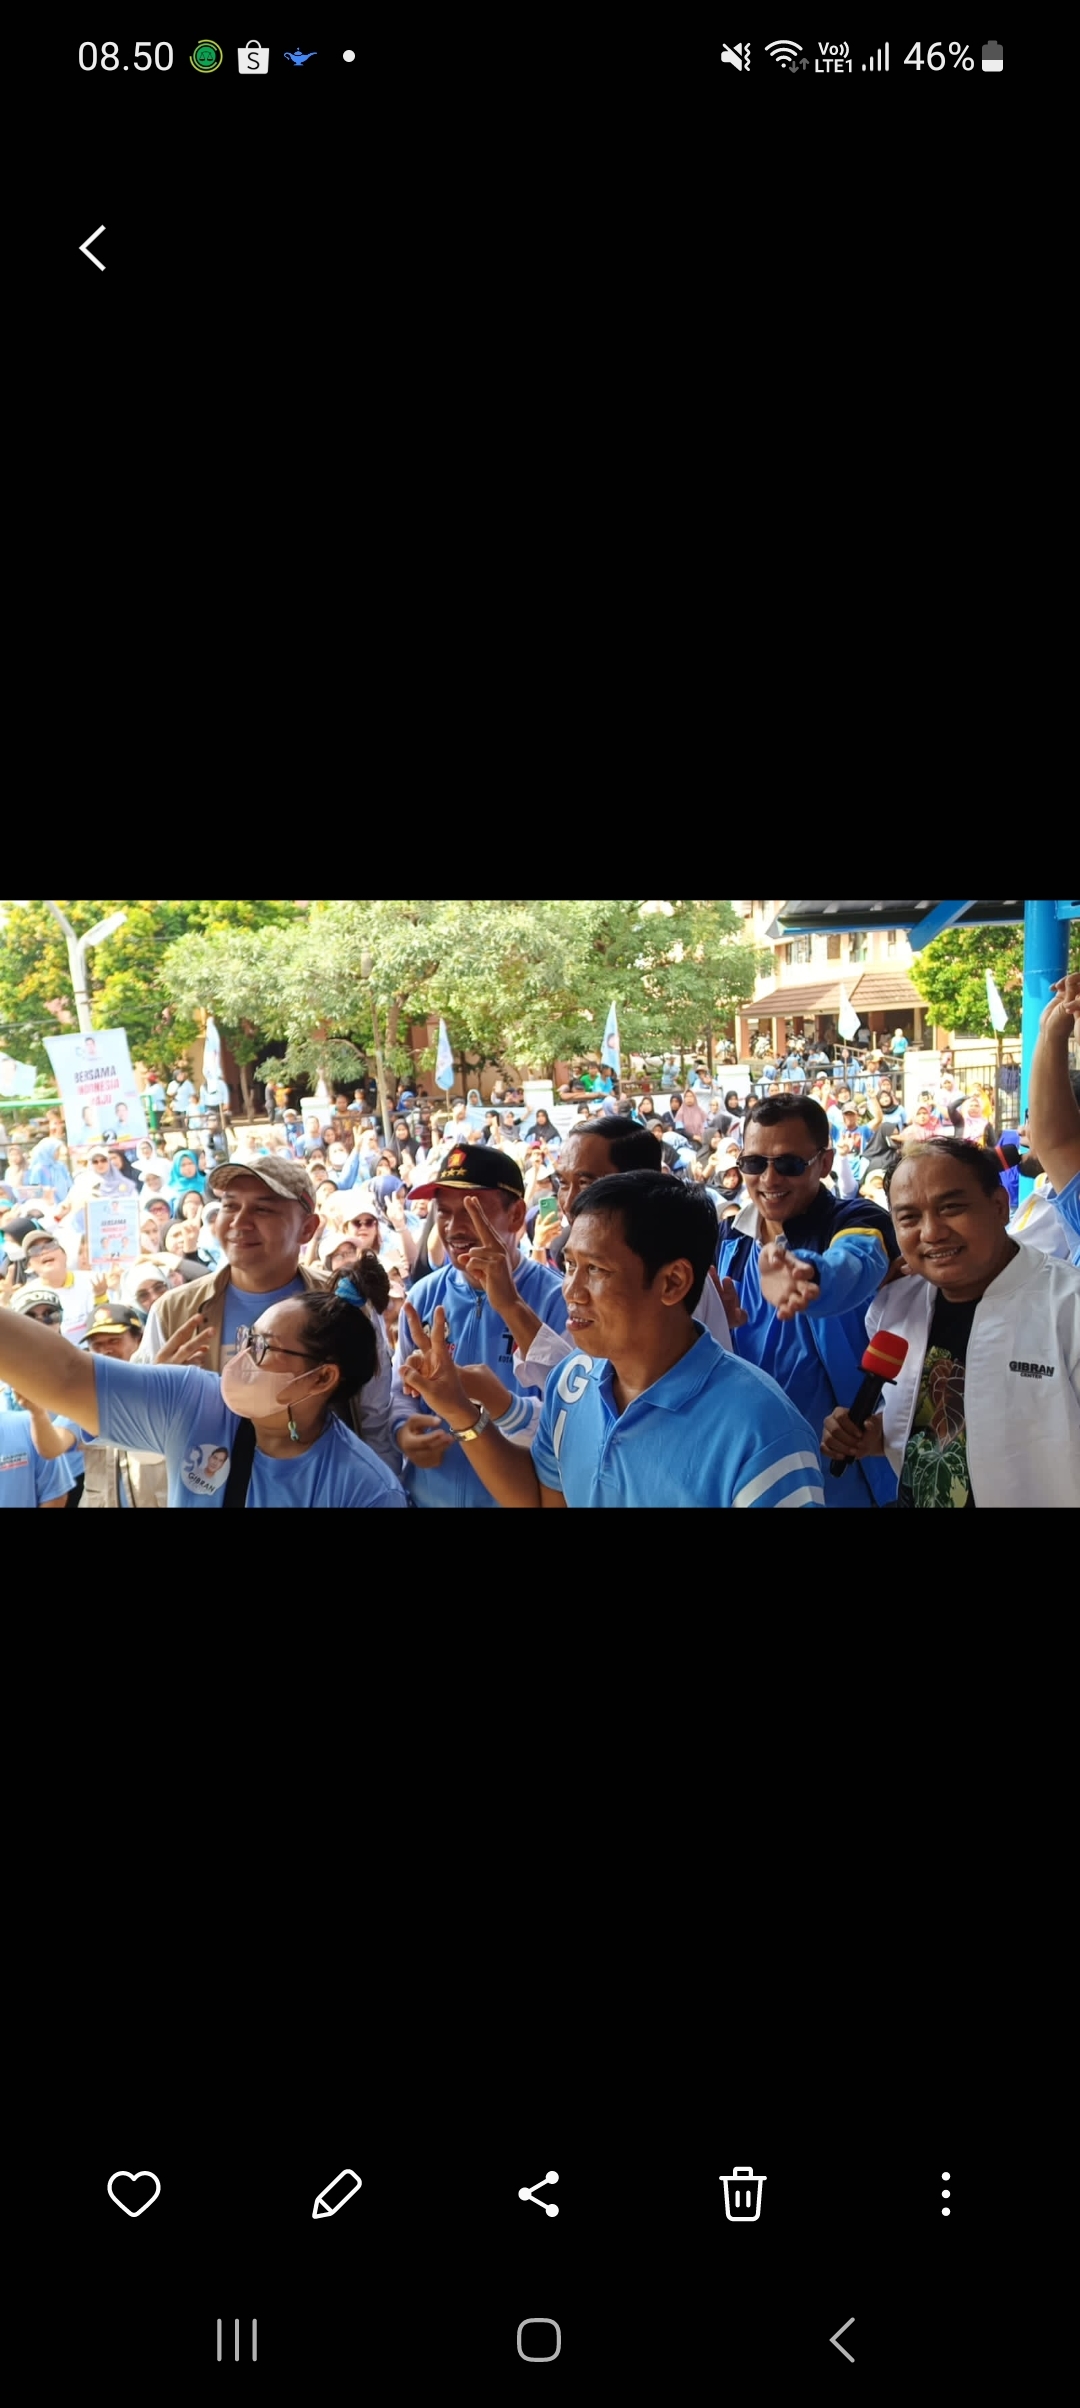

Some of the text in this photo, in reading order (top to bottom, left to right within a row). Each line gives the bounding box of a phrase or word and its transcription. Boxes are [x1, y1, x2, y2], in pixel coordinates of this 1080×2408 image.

[78, 41, 174, 71] 08.50
[815, 59, 852, 73] LTE1
[903, 41, 975, 71] 46%
[74, 1065, 117, 1084] BERSAMA
[1009, 1361, 1055, 1377] GIBRAN
[188, 1472, 215, 1493] GIBRAN
